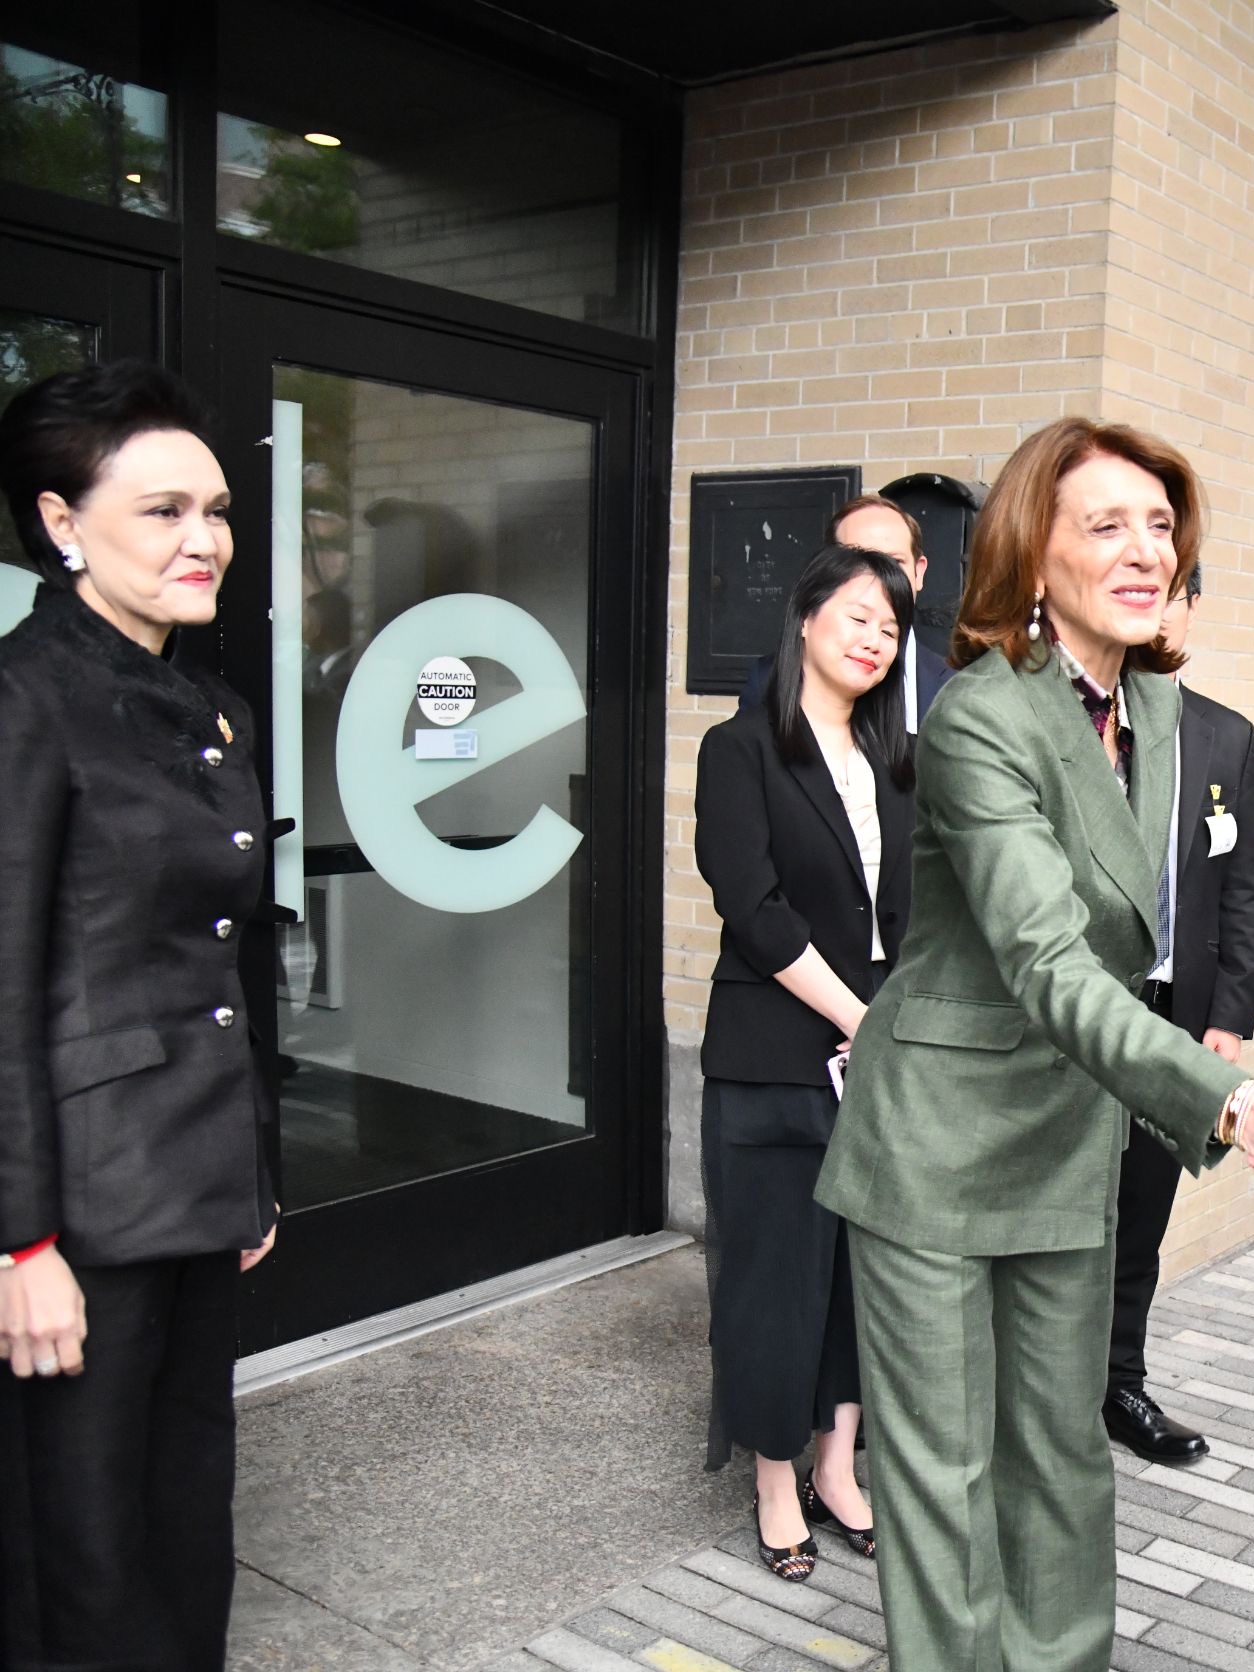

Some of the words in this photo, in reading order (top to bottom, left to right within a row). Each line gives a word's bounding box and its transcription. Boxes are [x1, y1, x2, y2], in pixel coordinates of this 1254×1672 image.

[420, 672, 472, 681] AUTOMATIC
[419, 685, 474, 698] CAUTION
[434, 703, 460, 711] DOOR
